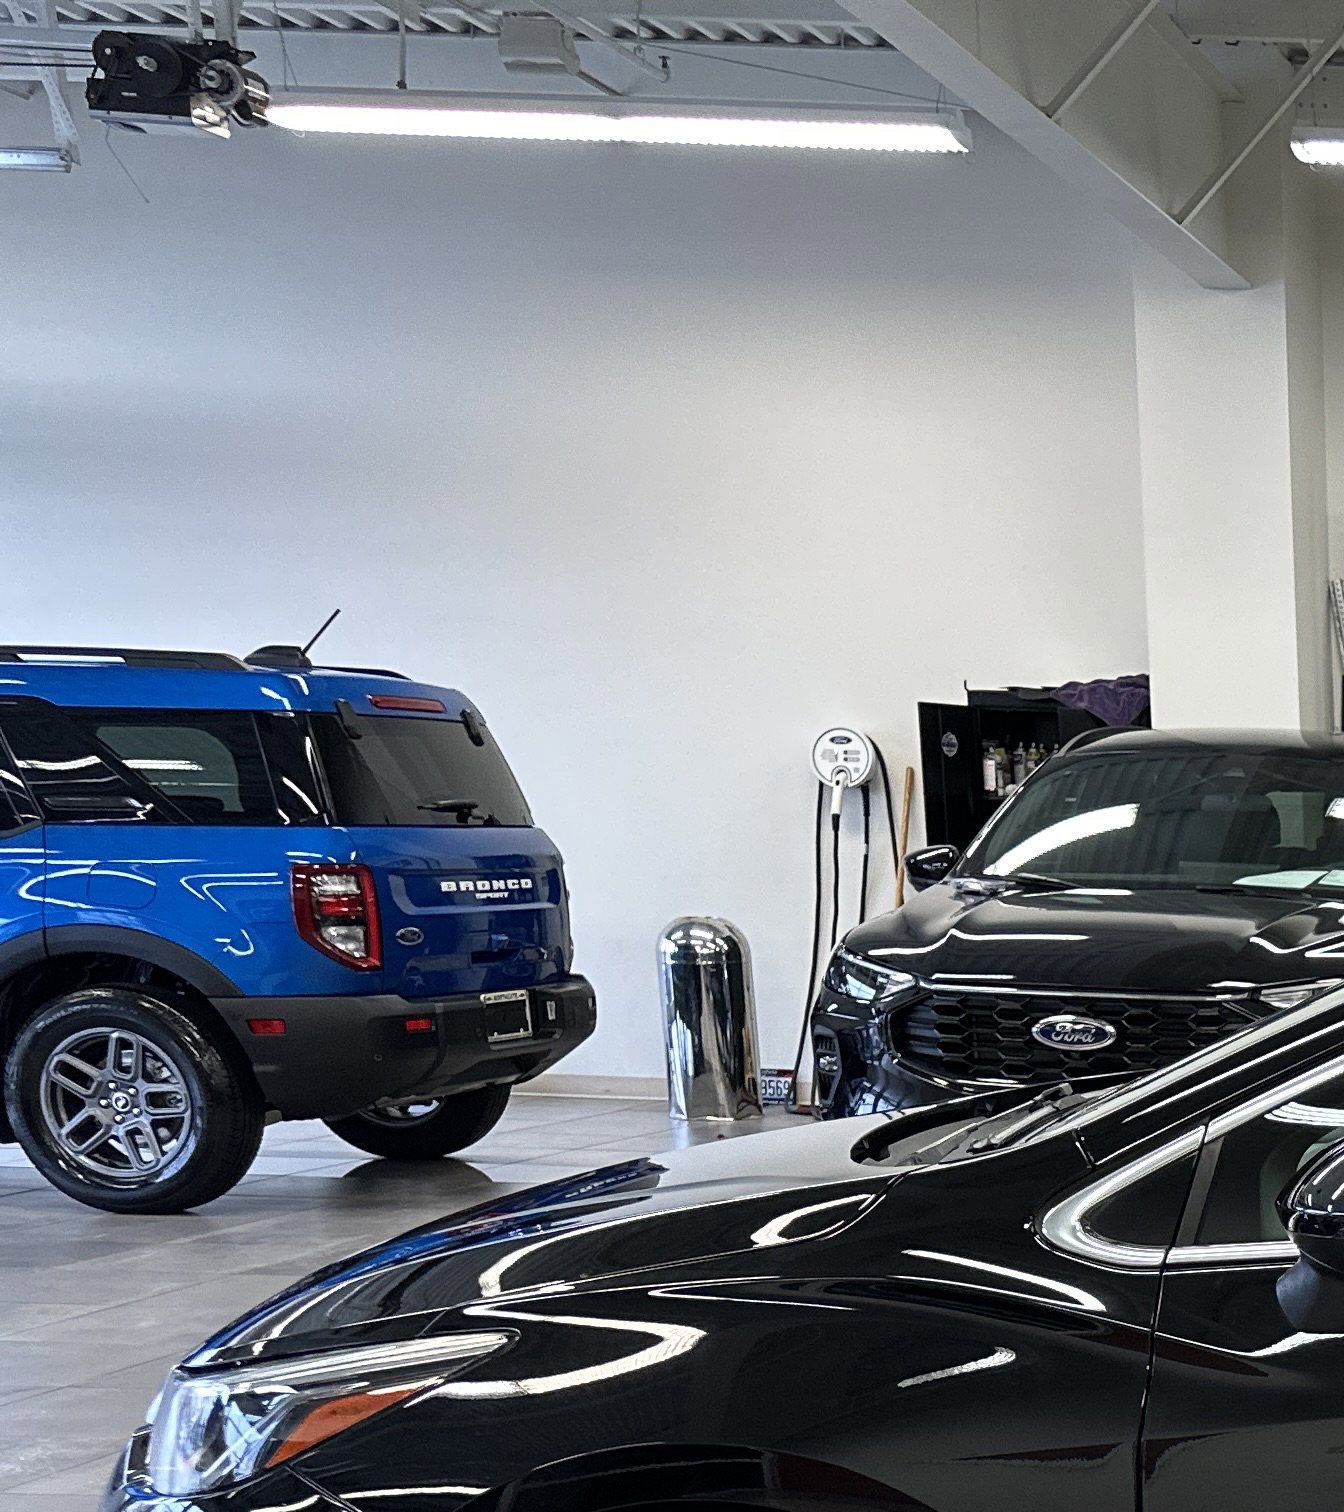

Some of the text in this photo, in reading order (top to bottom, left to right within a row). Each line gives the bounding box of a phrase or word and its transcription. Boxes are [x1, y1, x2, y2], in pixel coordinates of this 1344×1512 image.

[440, 878, 533, 892] BRONCO
[475, 891, 509, 899] SPORT
[1051, 1022, 1096, 1043] Ford
